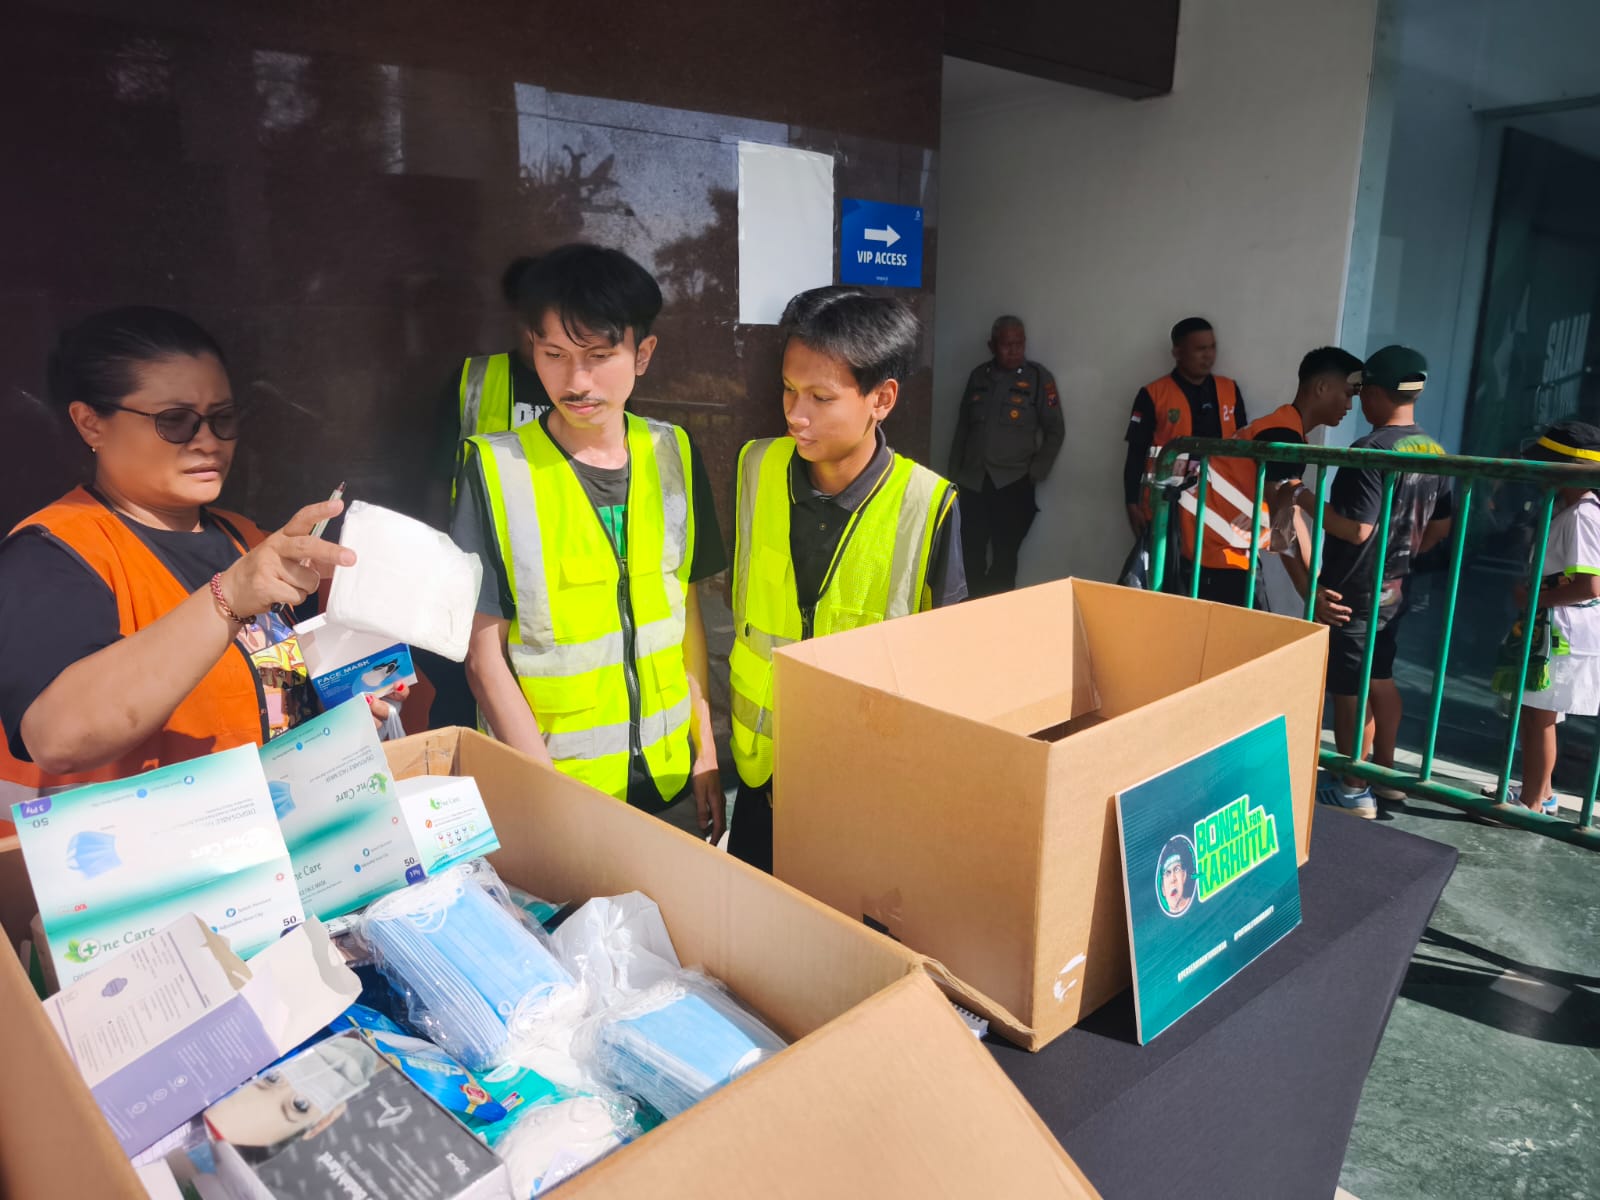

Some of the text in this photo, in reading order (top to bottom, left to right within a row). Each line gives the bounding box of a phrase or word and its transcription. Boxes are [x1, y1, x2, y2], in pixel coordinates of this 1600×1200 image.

[857, 250, 908, 266] VIP ACCESS
[316, 659, 370, 685] FACE MASK
[335, 787, 355, 802] Care
[32, 817, 49, 829] 50
[1195, 797, 1262, 860] BONEK FOR
[404, 857, 415, 867] 50
[1197, 818, 1277, 897] KARHUTLA
[303, 862, 322, 877] Care
[283, 915, 297, 927] 50
[123, 927, 157, 944] Care
